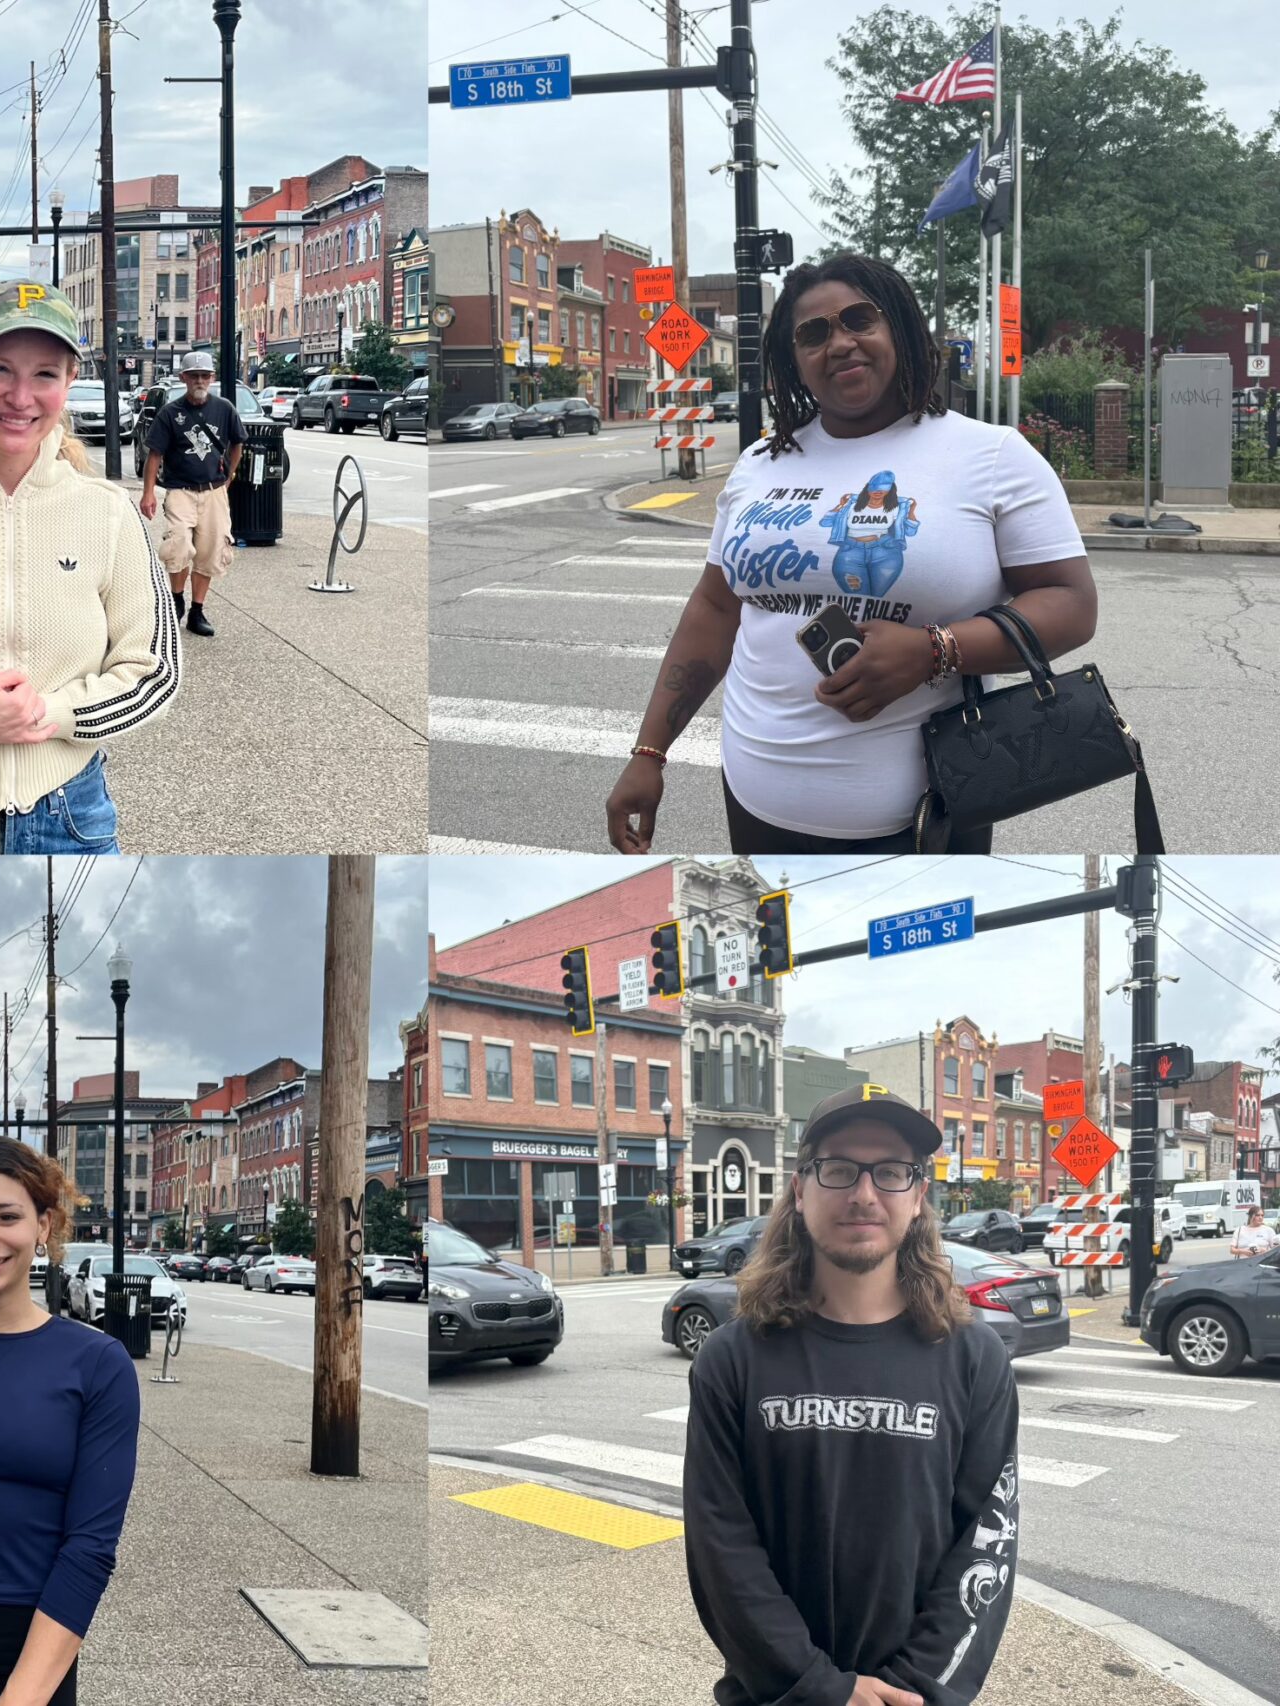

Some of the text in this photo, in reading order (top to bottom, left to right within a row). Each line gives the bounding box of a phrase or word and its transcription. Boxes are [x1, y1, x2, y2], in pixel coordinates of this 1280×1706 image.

[463, 61, 555, 78] 70 South Side Flats 90
[467, 77, 552, 100] S 18th St
[636, 273, 672, 283] BIRMINGHAM
[17, 284, 45, 309] P
[644, 286, 665, 295] BRIDGE
[661, 319, 689, 329] ROAD
[661, 330, 691, 341] WORK
[662, 342, 690, 352] 1500 FT
[790, 488, 824, 501] THE
[734, 501, 813, 531] Middle
[851, 514, 889, 525] DIANA
[722, 531, 819, 590] Sister
[862, 598, 912, 624] RULES
[882, 920, 958, 950] S 18th St
[723, 939, 738, 952] NO
[721, 953, 741, 963] TURN
[624, 970, 641, 980] YIELD
[719, 962, 746, 975] ON RED
[862, 1083, 889, 1101] P
[1046, 1088, 1081, 1099] BIRMINGHAM
[1053, 1102, 1074, 1112] BRIDGE
[1070, 1133, 1098, 1144] ROAD
[492, 1141, 557, 1156] BRUEGGER'S
[560, 1145, 591, 1157] BAGEL
[1069, 1144, 1100, 1157] WORK
[1070, 1157, 1099, 1168] 1500 FT
[760, 1397, 939, 1437] TURNSTILE
